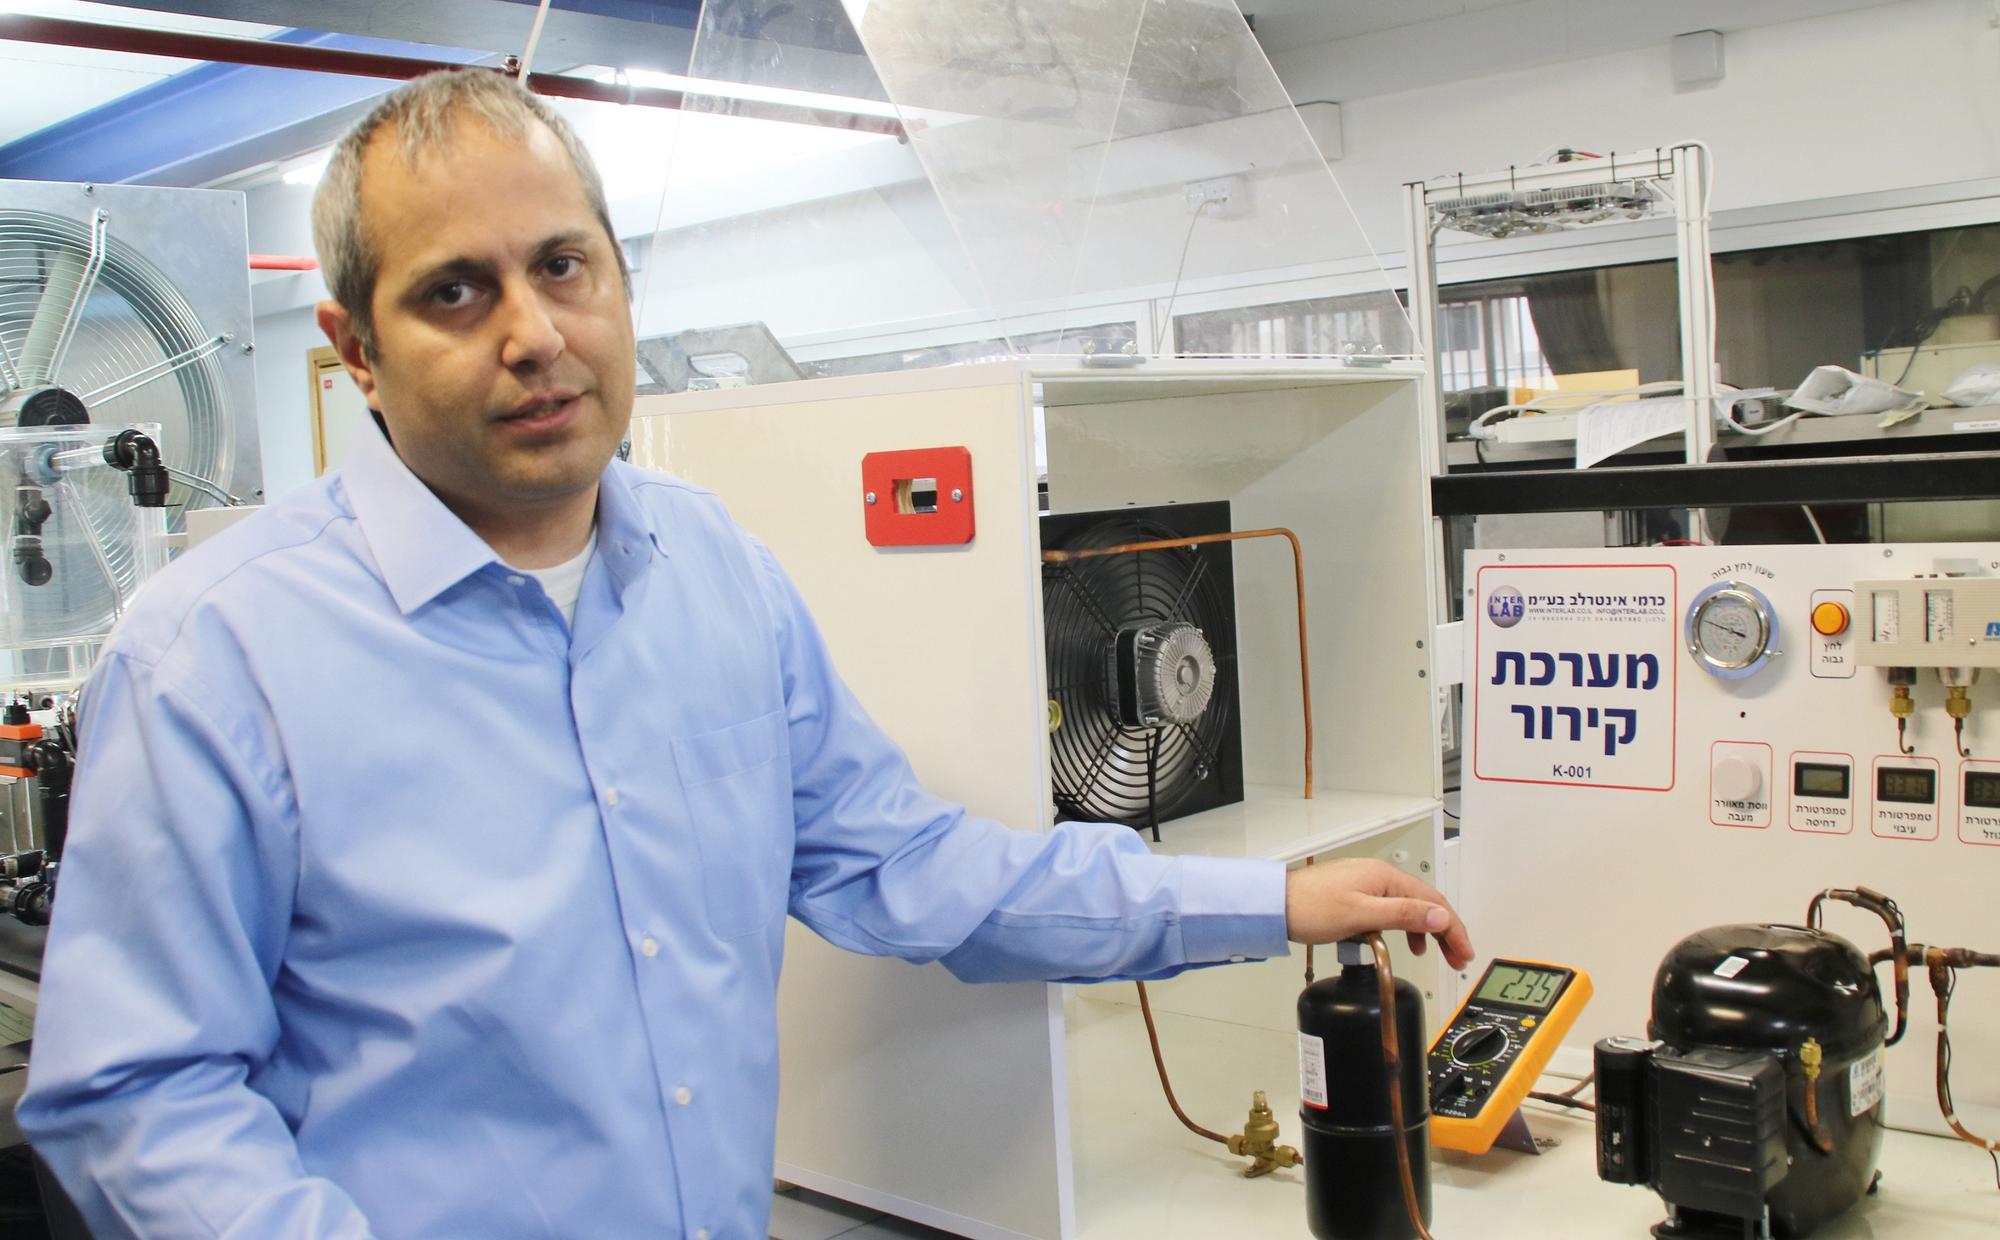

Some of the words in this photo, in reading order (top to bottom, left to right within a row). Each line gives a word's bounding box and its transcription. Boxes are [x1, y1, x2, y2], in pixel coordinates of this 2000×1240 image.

[1711, 564, 1732, 580] גבוה
[1734, 561, 1753, 573] לחץ
[1489, 596, 1523, 604] INTER
[1569, 592, 1627, 606] אינטרלב
[1633, 595, 1666, 606] כרמי
[1490, 604, 1523, 617] LAB
[1823, 640, 1843, 651] לחץ
[1821, 655, 1844, 664] גבוה
[1491, 650, 1660, 691] מערכת
[1511, 704, 1637, 756] קירור
[1553, 764, 1592, 779] K-001
[1714, 800, 1746, 810] מאוורר
[1795, 804, 1847, 816] טמפרטורת
[1727, 812, 1754, 823] מעבה
[1878, 810, 1932, 822] טמפרטורת
[1965, 816, 2000, 826] רטורת
[1805, 818, 1836, 828] דחיסה
[1893, 824, 1917, 834] עיבוי
[1499, 968, 1560, 1004] 2.35
